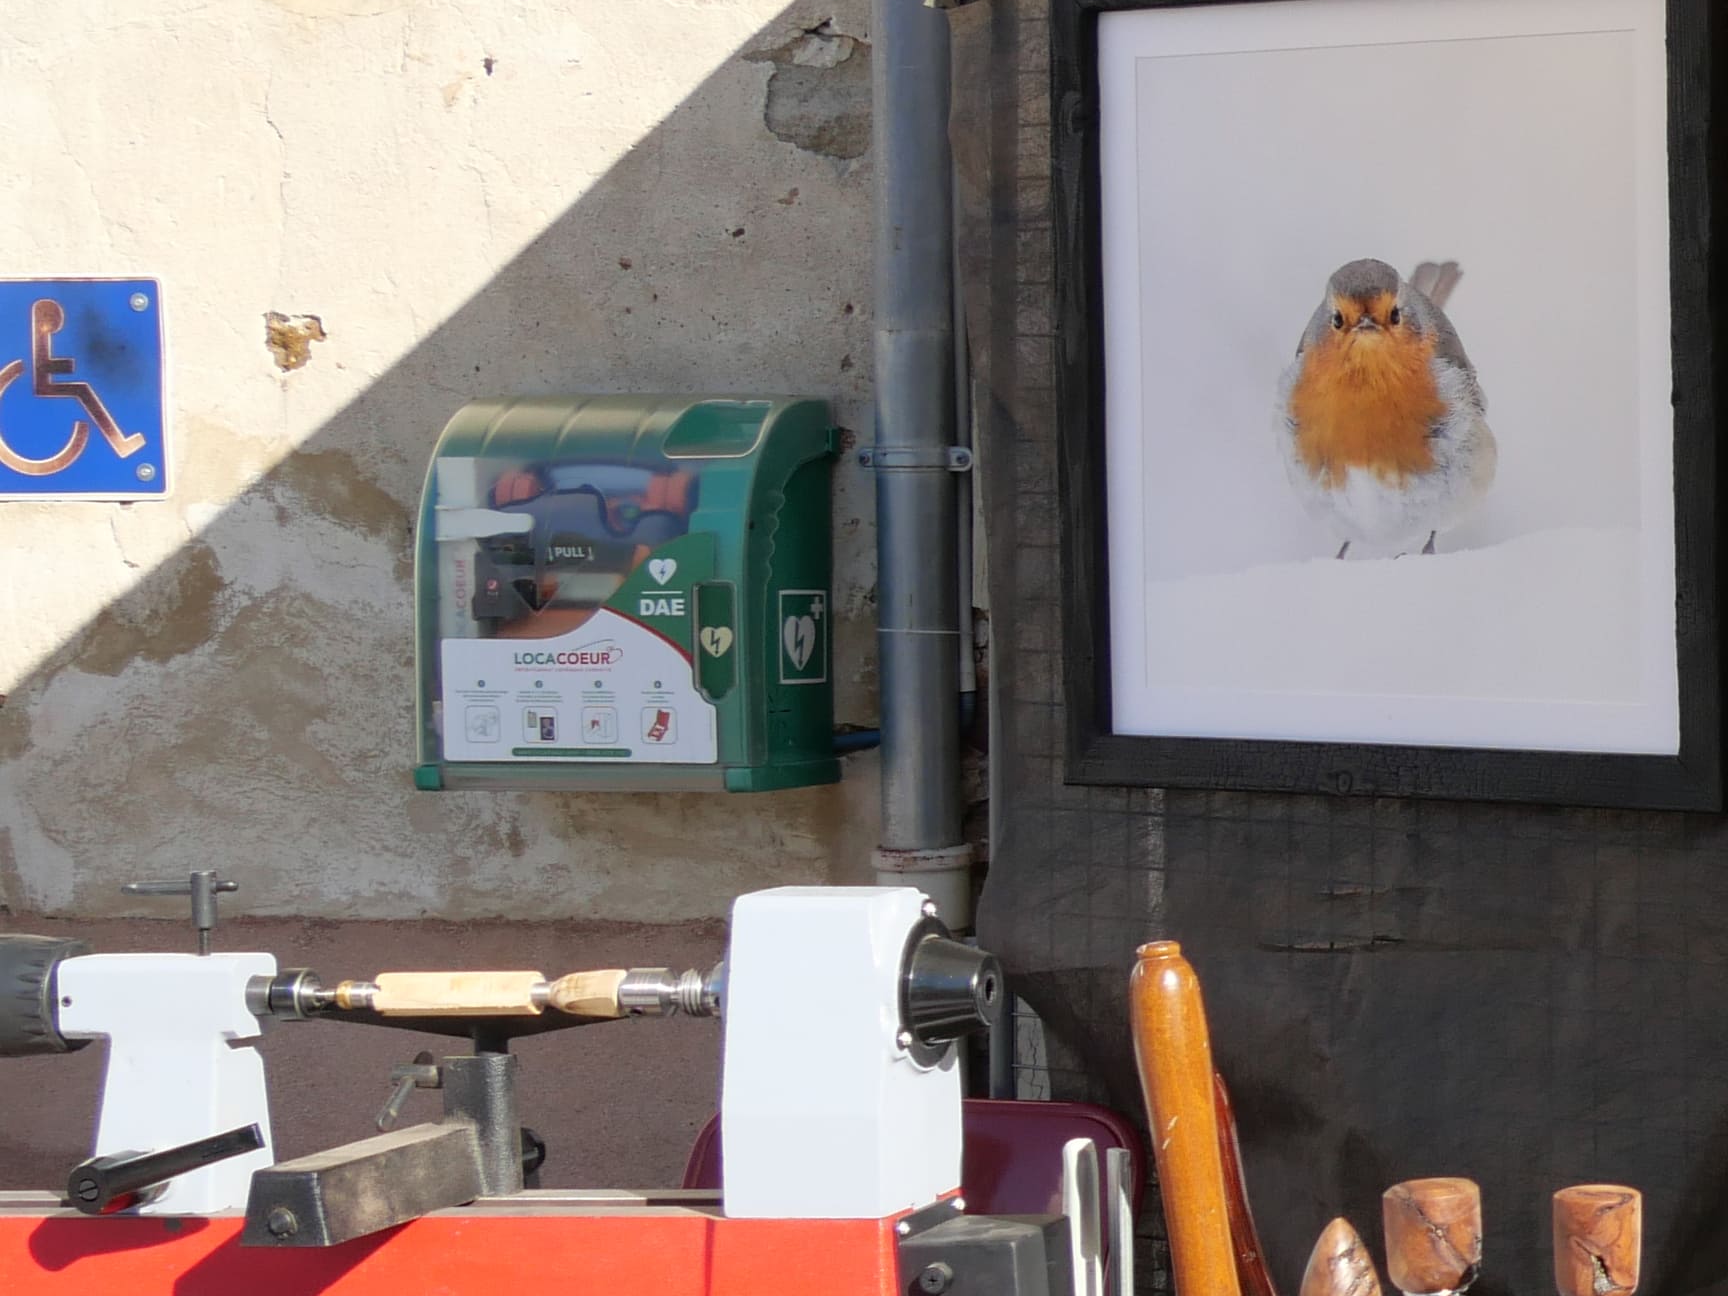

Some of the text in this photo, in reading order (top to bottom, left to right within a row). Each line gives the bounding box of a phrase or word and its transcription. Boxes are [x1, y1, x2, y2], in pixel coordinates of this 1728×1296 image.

[554, 546, 586, 559] PULL
[640, 598, 686, 616] DAE
[514, 652, 610, 665] LOCACOEUR
